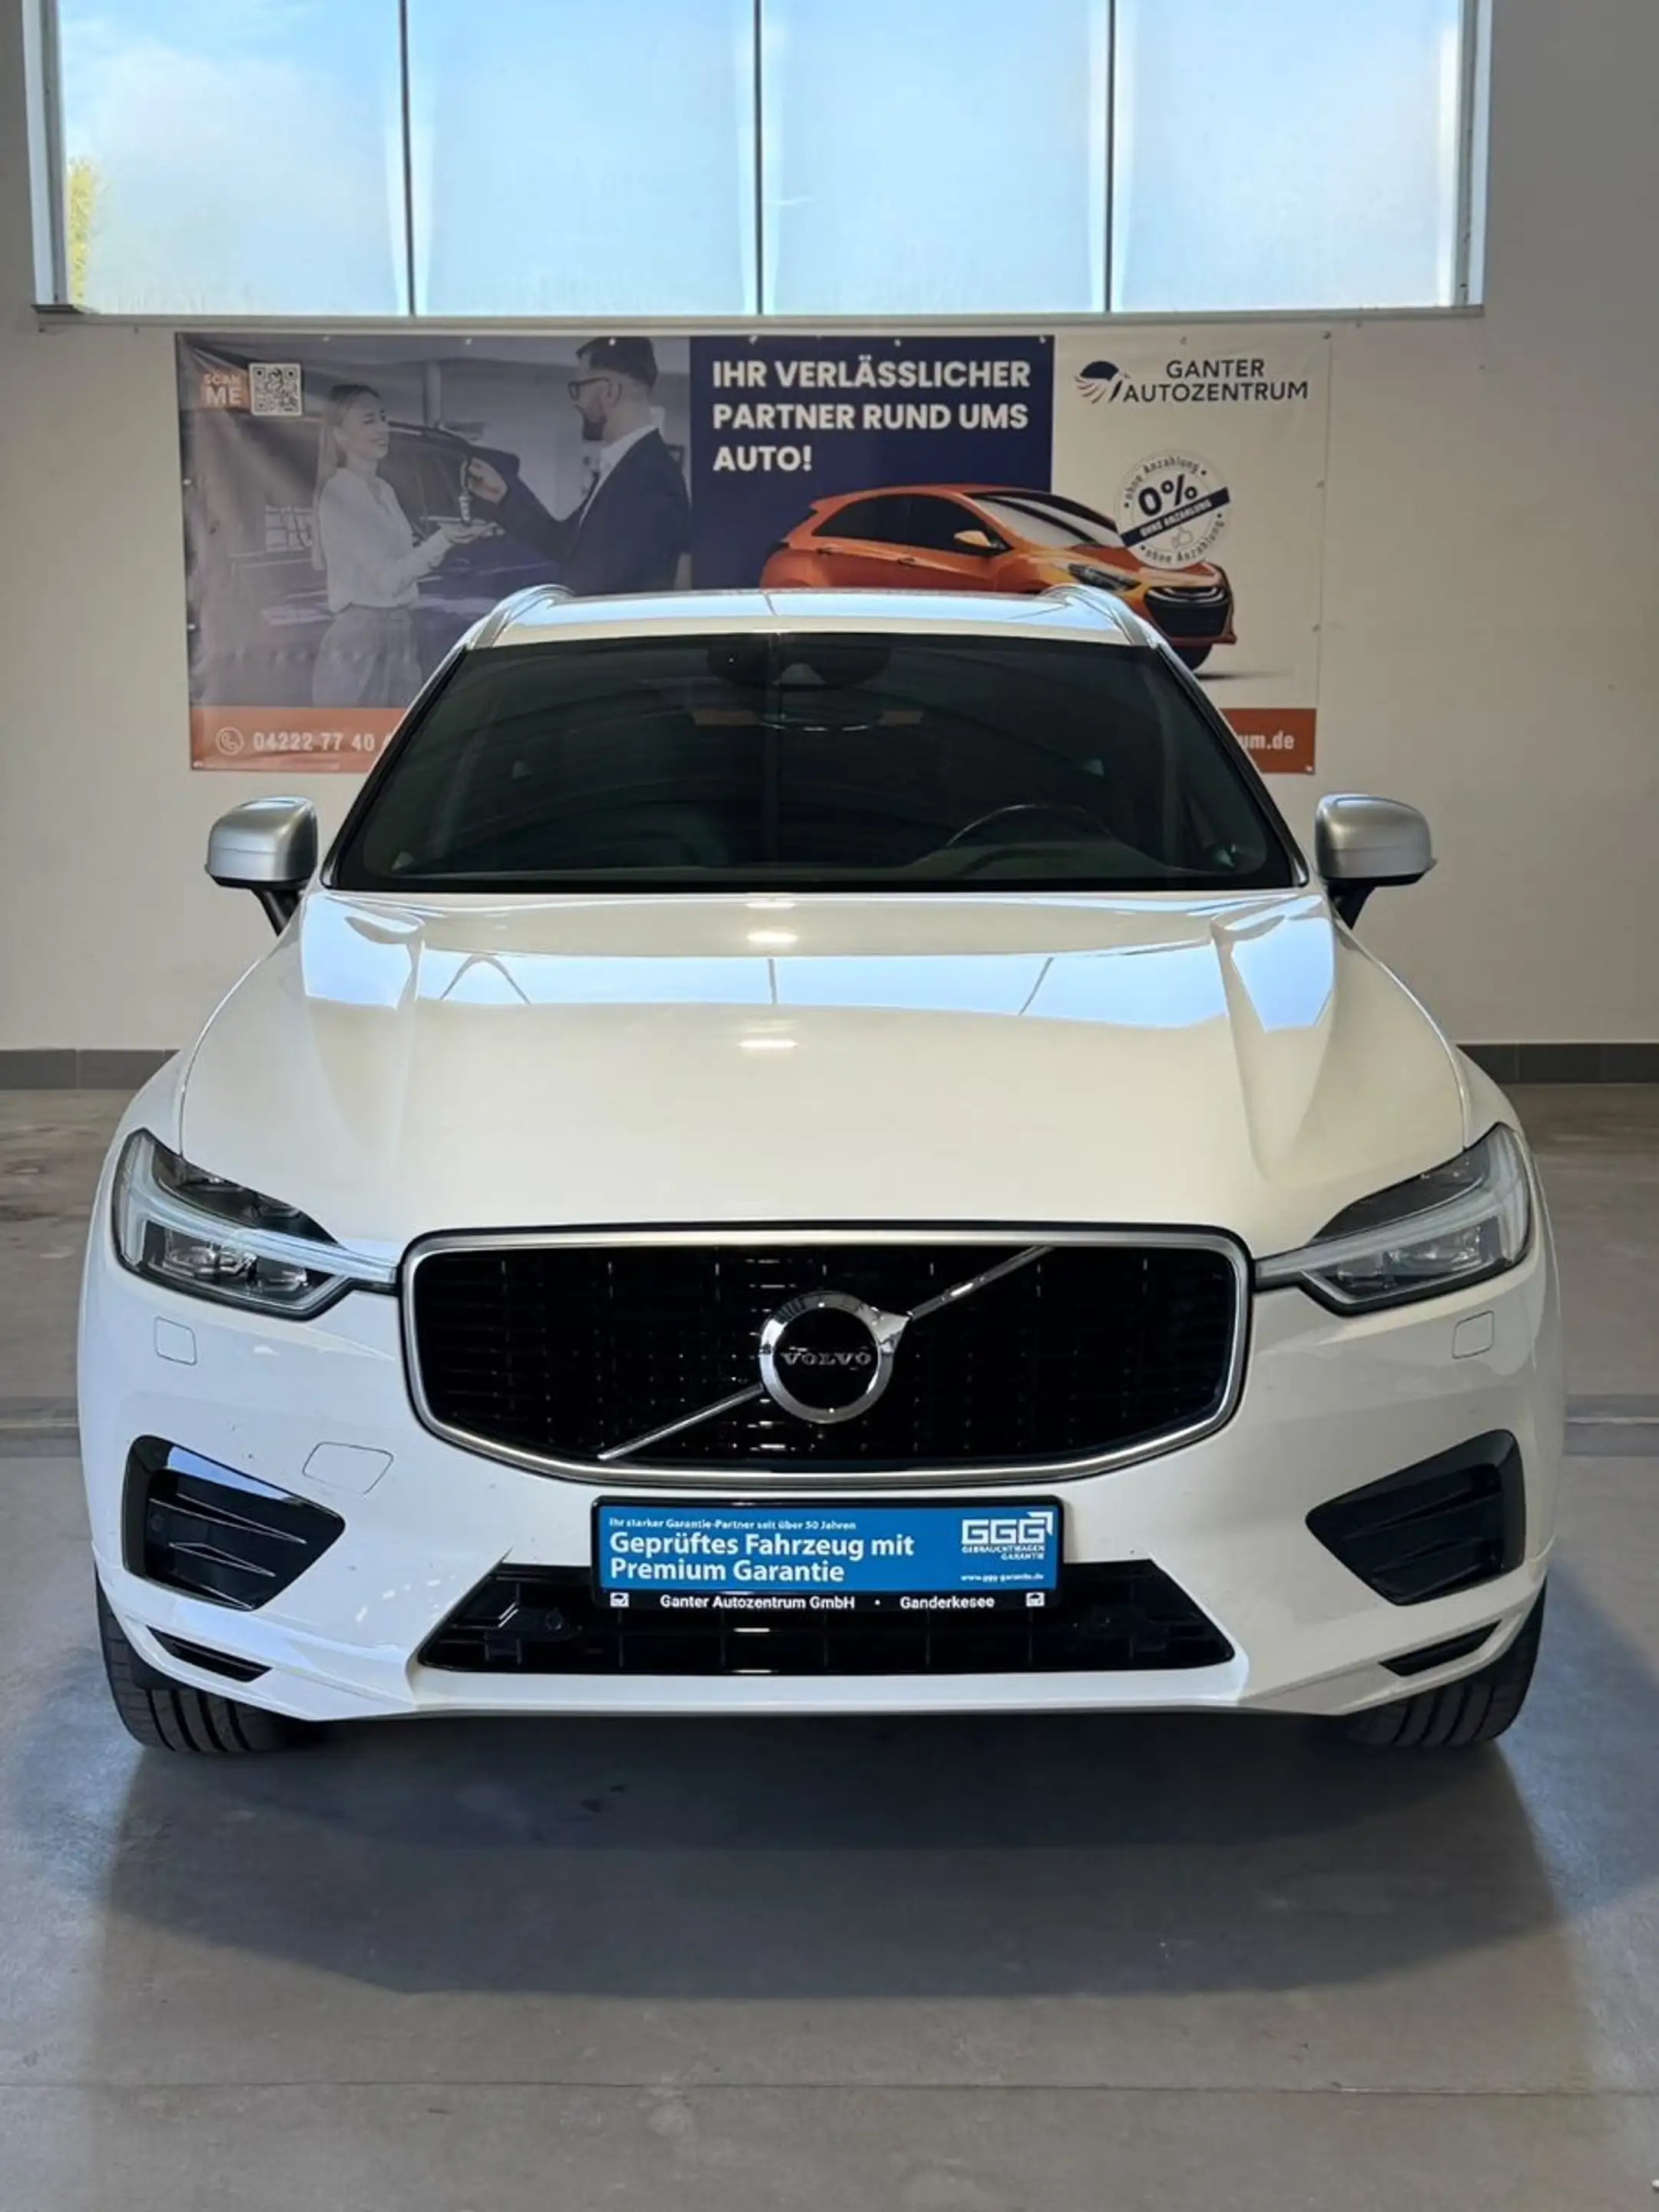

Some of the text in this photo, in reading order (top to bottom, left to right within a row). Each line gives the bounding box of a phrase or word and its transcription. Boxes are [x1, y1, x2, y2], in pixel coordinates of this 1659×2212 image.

[713, 354, 1030, 388] IHR VERLÄSSLICHER
[1165, 359, 1265, 379] GANTER
[206, 386, 243, 405] ME
[1122, 381, 1309, 402] AUTOZENTRUM
[713, 403, 1029, 429] PARTNER RUND UMS
[713, 445, 813, 472] AUTO!
[1138, 473, 1198, 517] 0%
[253, 732, 313, 752] 04222
[320, 732, 344, 751] 77
[351, 733, 376, 752] 40
[780, 1352, 871, 1366] VOLVO
[820, 1520, 856, 1530] Jahren
[962, 1518, 1045, 1544] GGG
[610, 1532, 914, 1561] Geprüftes Fahrzeug mit
[611, 1558, 846, 1582] Premium Garantie
[660, 1594, 995, 1611] Ganter Autozentrum GmbH Ganderkesee
